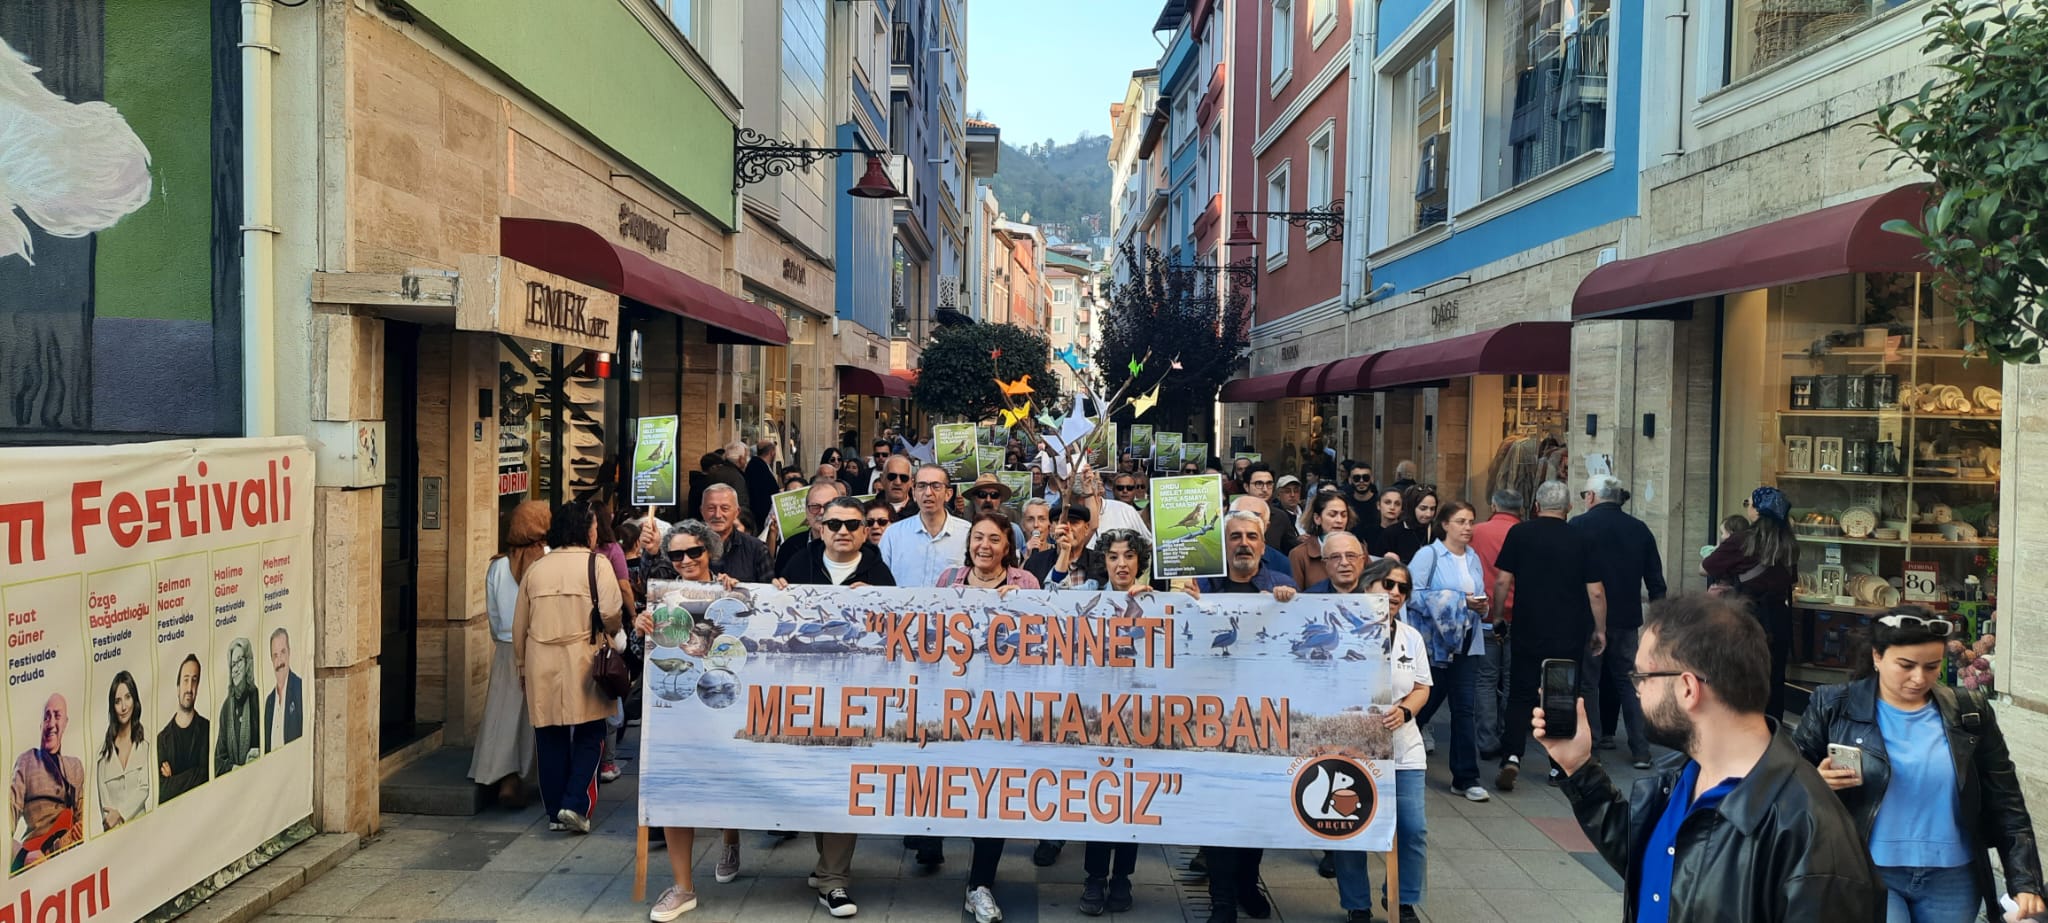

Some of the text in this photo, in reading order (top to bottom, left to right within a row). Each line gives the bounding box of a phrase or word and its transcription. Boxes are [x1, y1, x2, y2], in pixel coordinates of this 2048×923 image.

[526, 281, 588, 334] EMEK
[71, 455, 292, 555] Festivali
[263, 555, 290, 570] Mehmet
[214, 566, 244, 581] Halime
[157, 576, 192, 594] Selman
[214, 583, 239, 598] Güner
[1906, 574, 1936, 594] 80
[88, 591, 117, 609] Özge
[157, 597, 185, 612] Nacar
[215, 600, 246, 614] Festivalde
[8, 609, 37, 627] Fuat
[89, 602, 150, 629] Bağdatlıoğlu
[157, 612, 194, 630] Festivalde
[215, 614, 238, 628] Orduda
[8, 630, 45, 648] Güner
[92, 628, 132, 648] Festivalde
[157, 629, 185, 644] Orduda
[866, 605, 1175, 676] “KUŞ CENNETİ
[8, 649, 57, 670] Festivalde
[93, 646, 122, 663] Orduda
[9, 668, 45, 687] Orduda
[943, 689, 1089, 744] RANTA
[1100, 695, 1291, 750] KURBAN
[848, 757, 1183, 826] ETMEYECEĞİZ”
